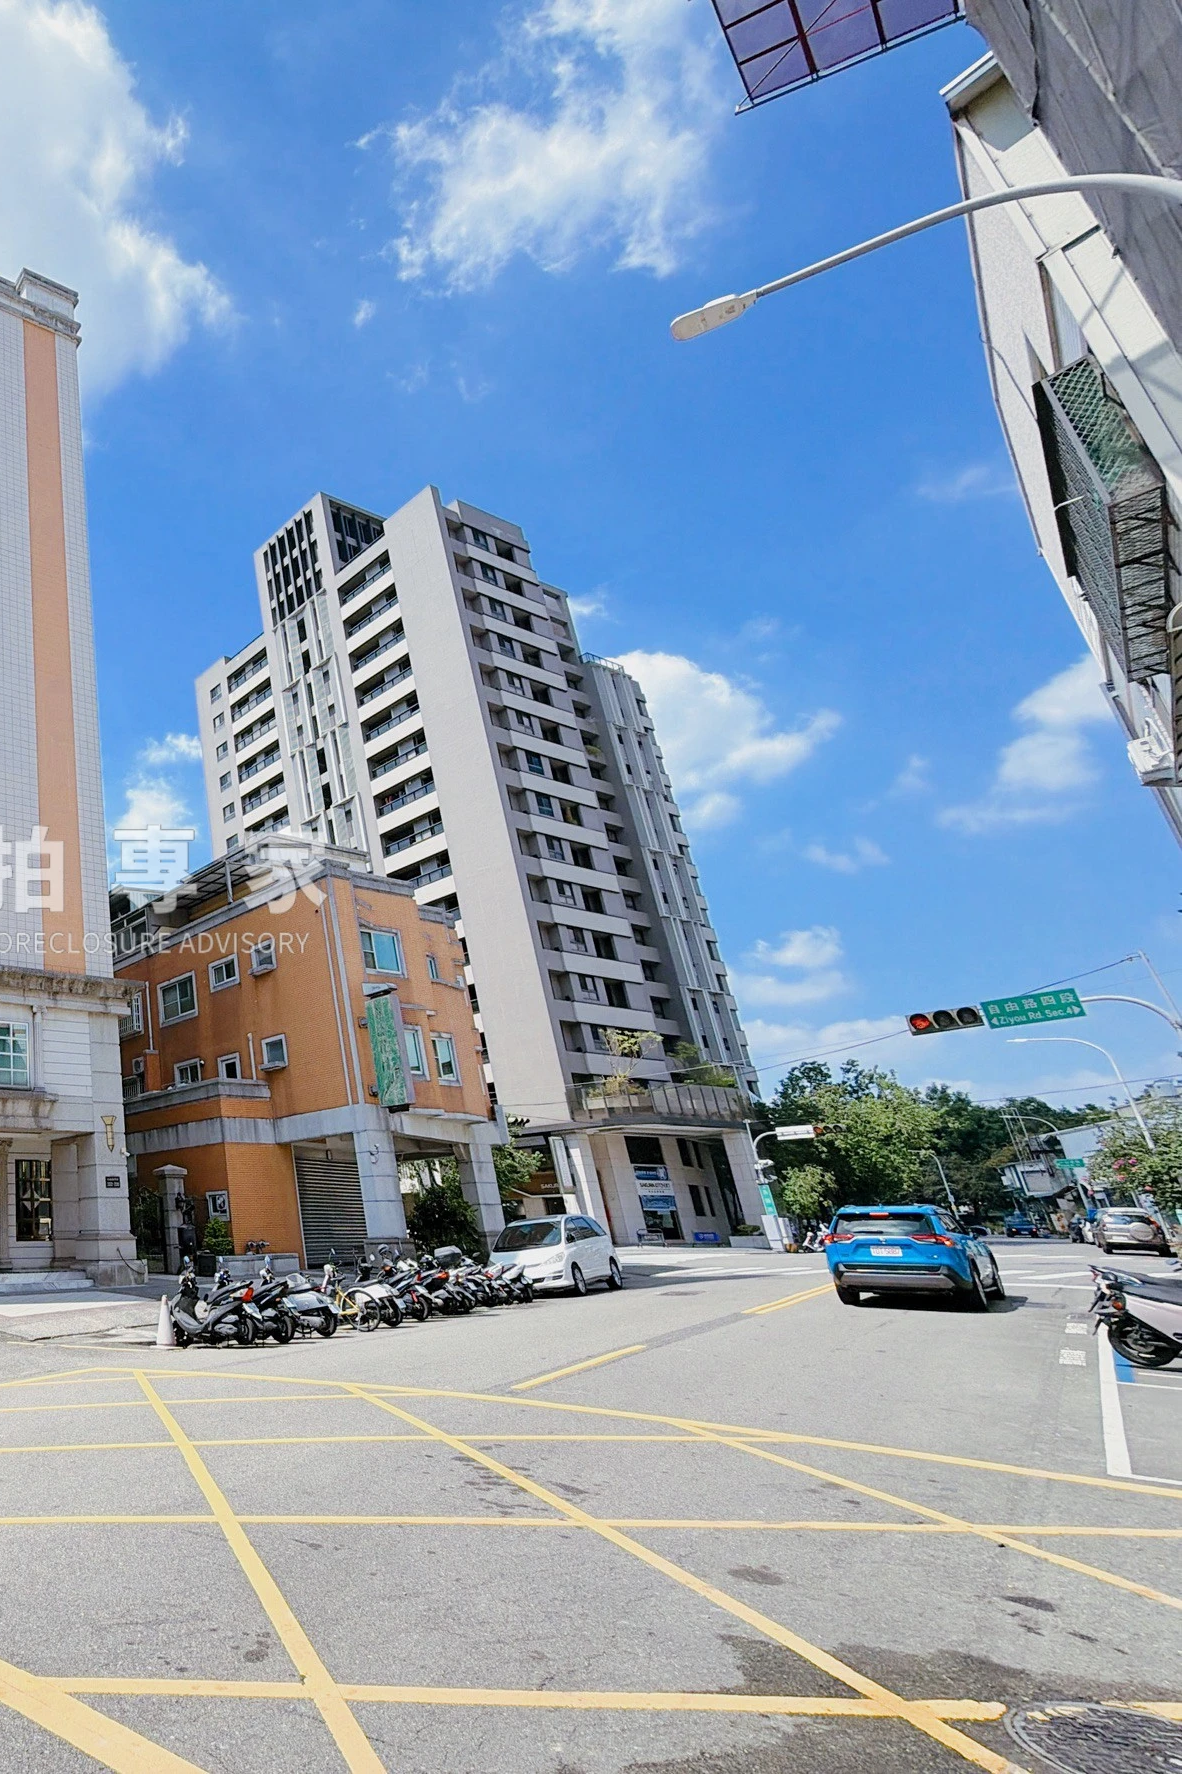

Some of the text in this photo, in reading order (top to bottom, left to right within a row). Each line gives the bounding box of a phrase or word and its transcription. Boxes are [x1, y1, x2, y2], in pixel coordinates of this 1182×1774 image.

[988, 992, 1076, 1015] 自由路四段
[998, 1014, 1027, 1024] Ziyou
[1028, 1011, 1042, 1020] Rd.
